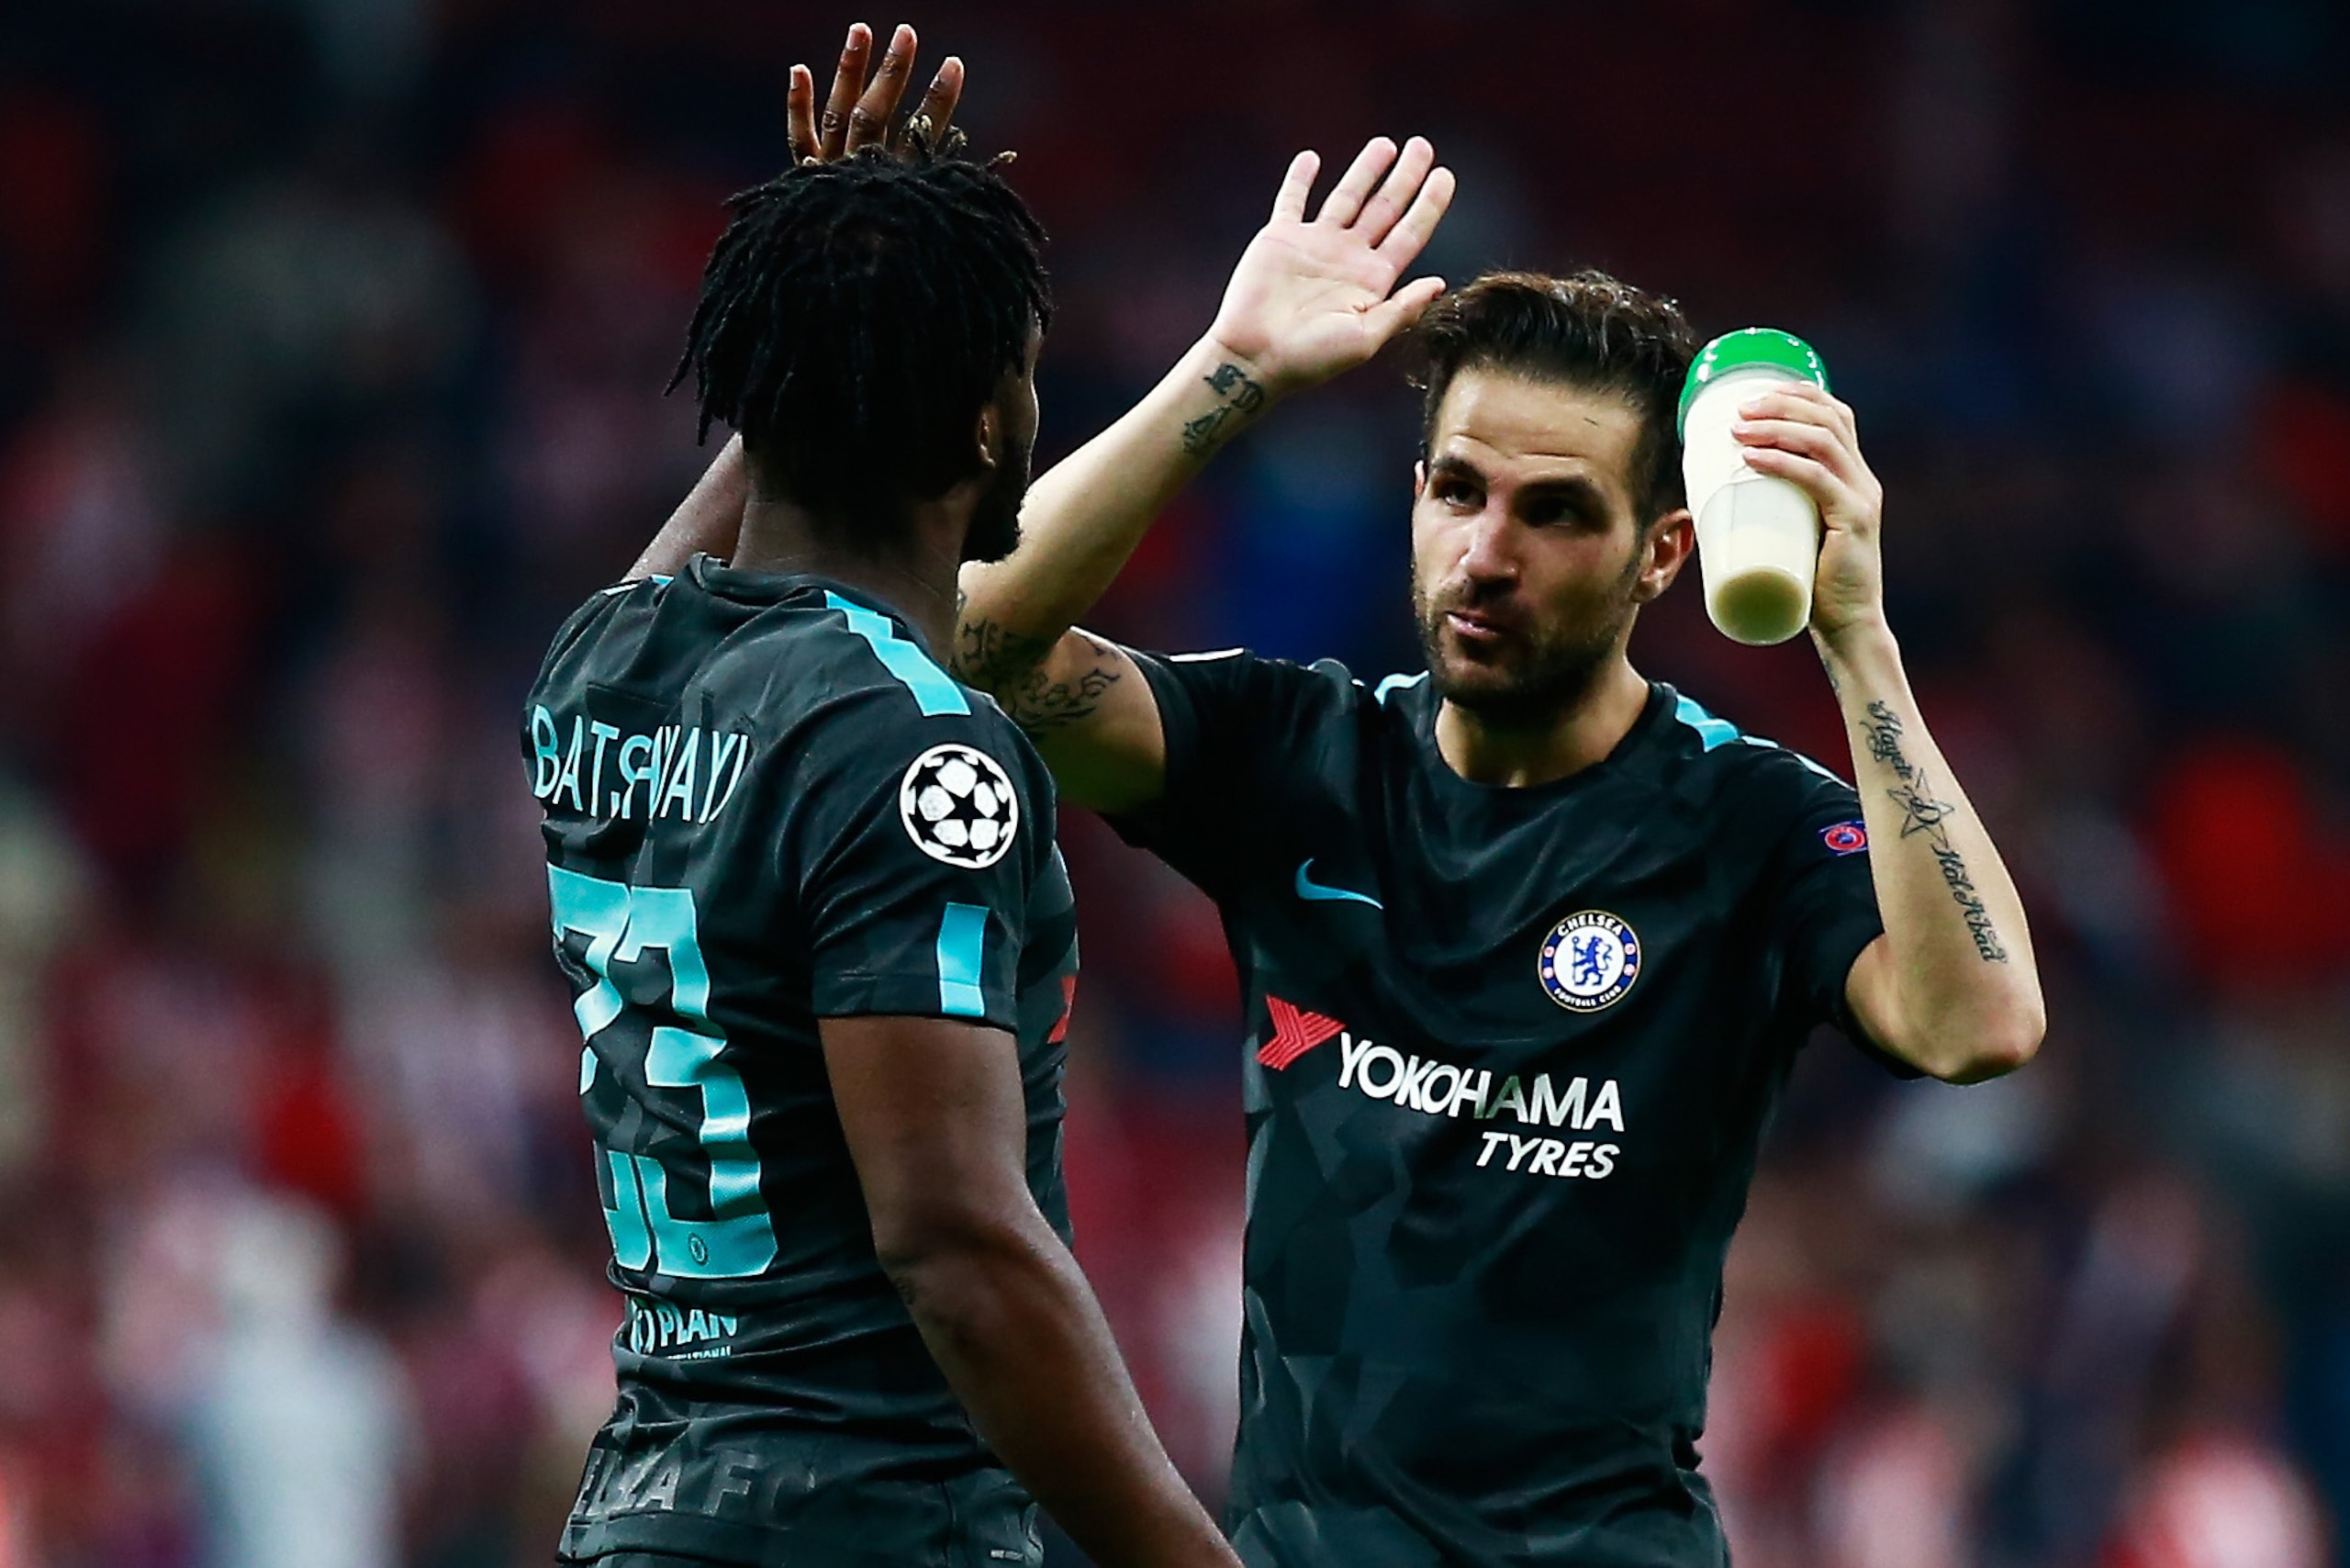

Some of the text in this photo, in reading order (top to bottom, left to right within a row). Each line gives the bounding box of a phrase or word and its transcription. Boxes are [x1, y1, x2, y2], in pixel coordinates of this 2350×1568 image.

[1557, 913, 1623, 936] CHELSEA
[1554, 988, 1597, 1007] FOOTBALL
[1338, 1032, 1625, 1132] YOKOHAMA
[1476, 1132, 1620, 1180] TYRES
